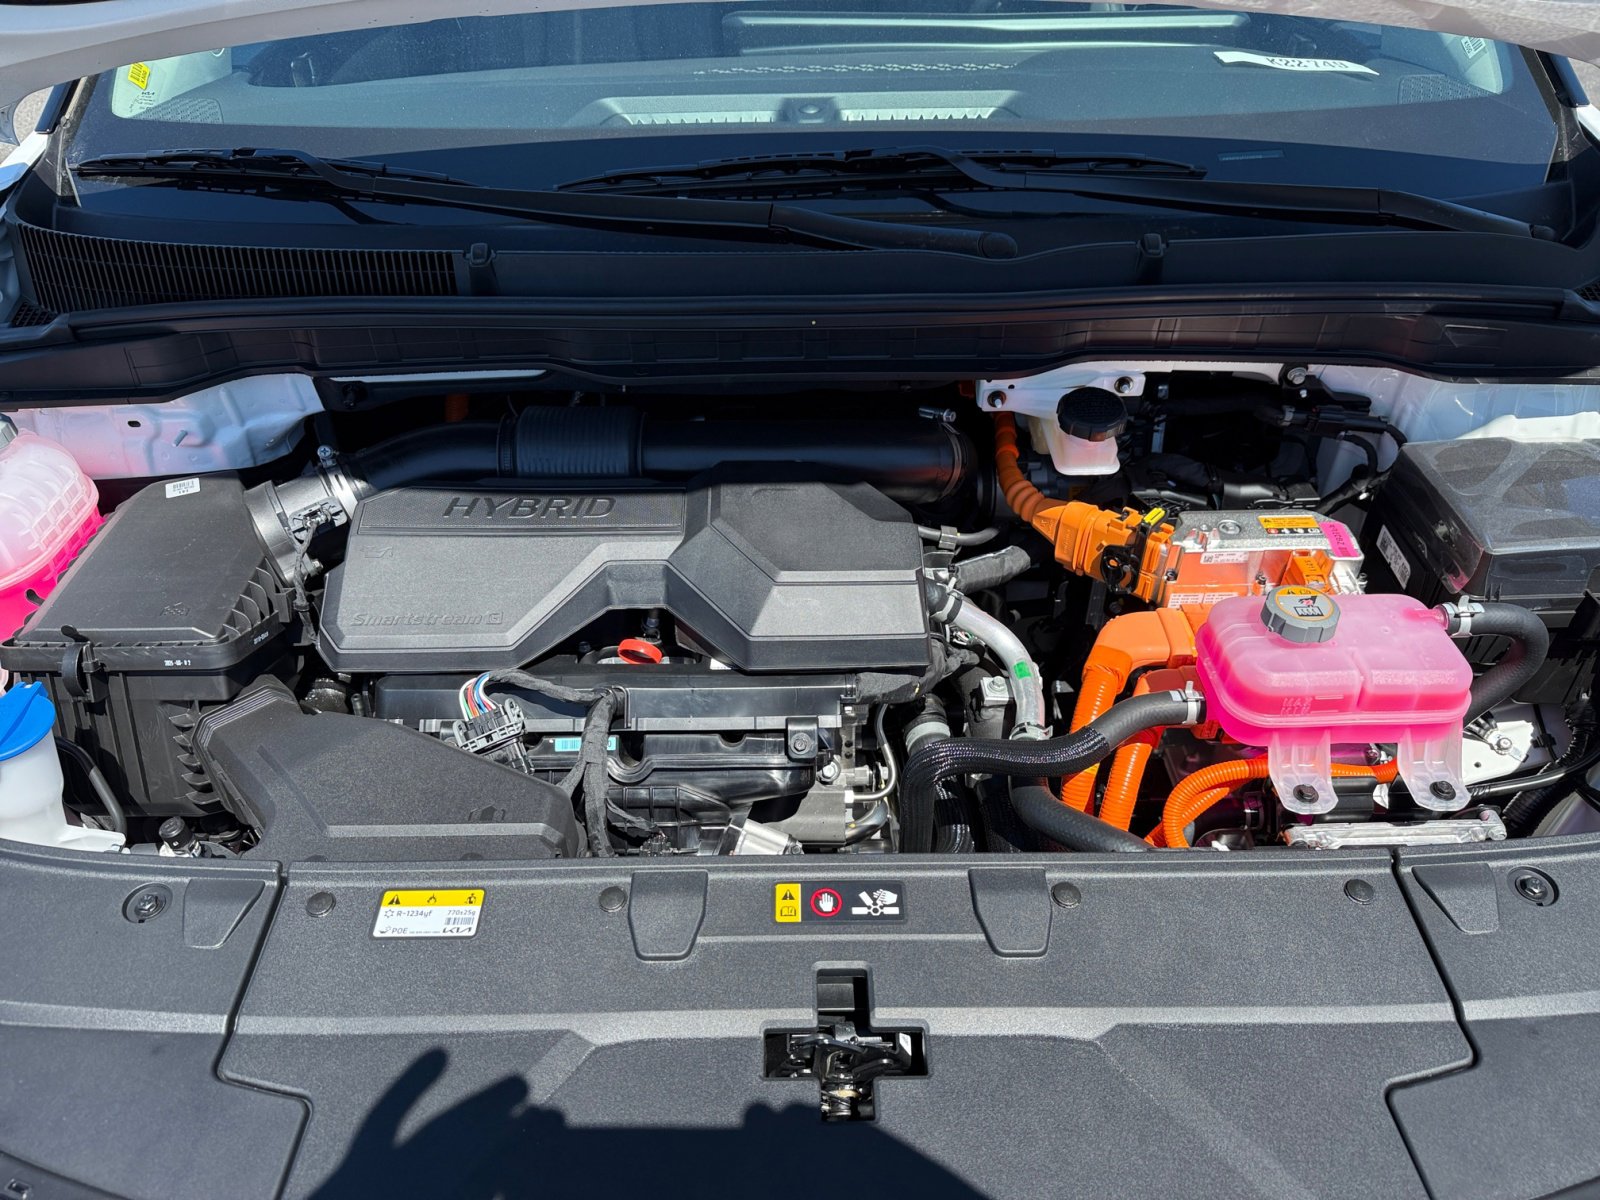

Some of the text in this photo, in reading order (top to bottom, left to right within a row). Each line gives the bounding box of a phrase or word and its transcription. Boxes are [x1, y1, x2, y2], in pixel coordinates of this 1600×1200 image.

[1266, 57, 1348, 69] K22749
[442, 497, 617, 519] HYBRID
[351, 612, 482, 626] Smartstream
